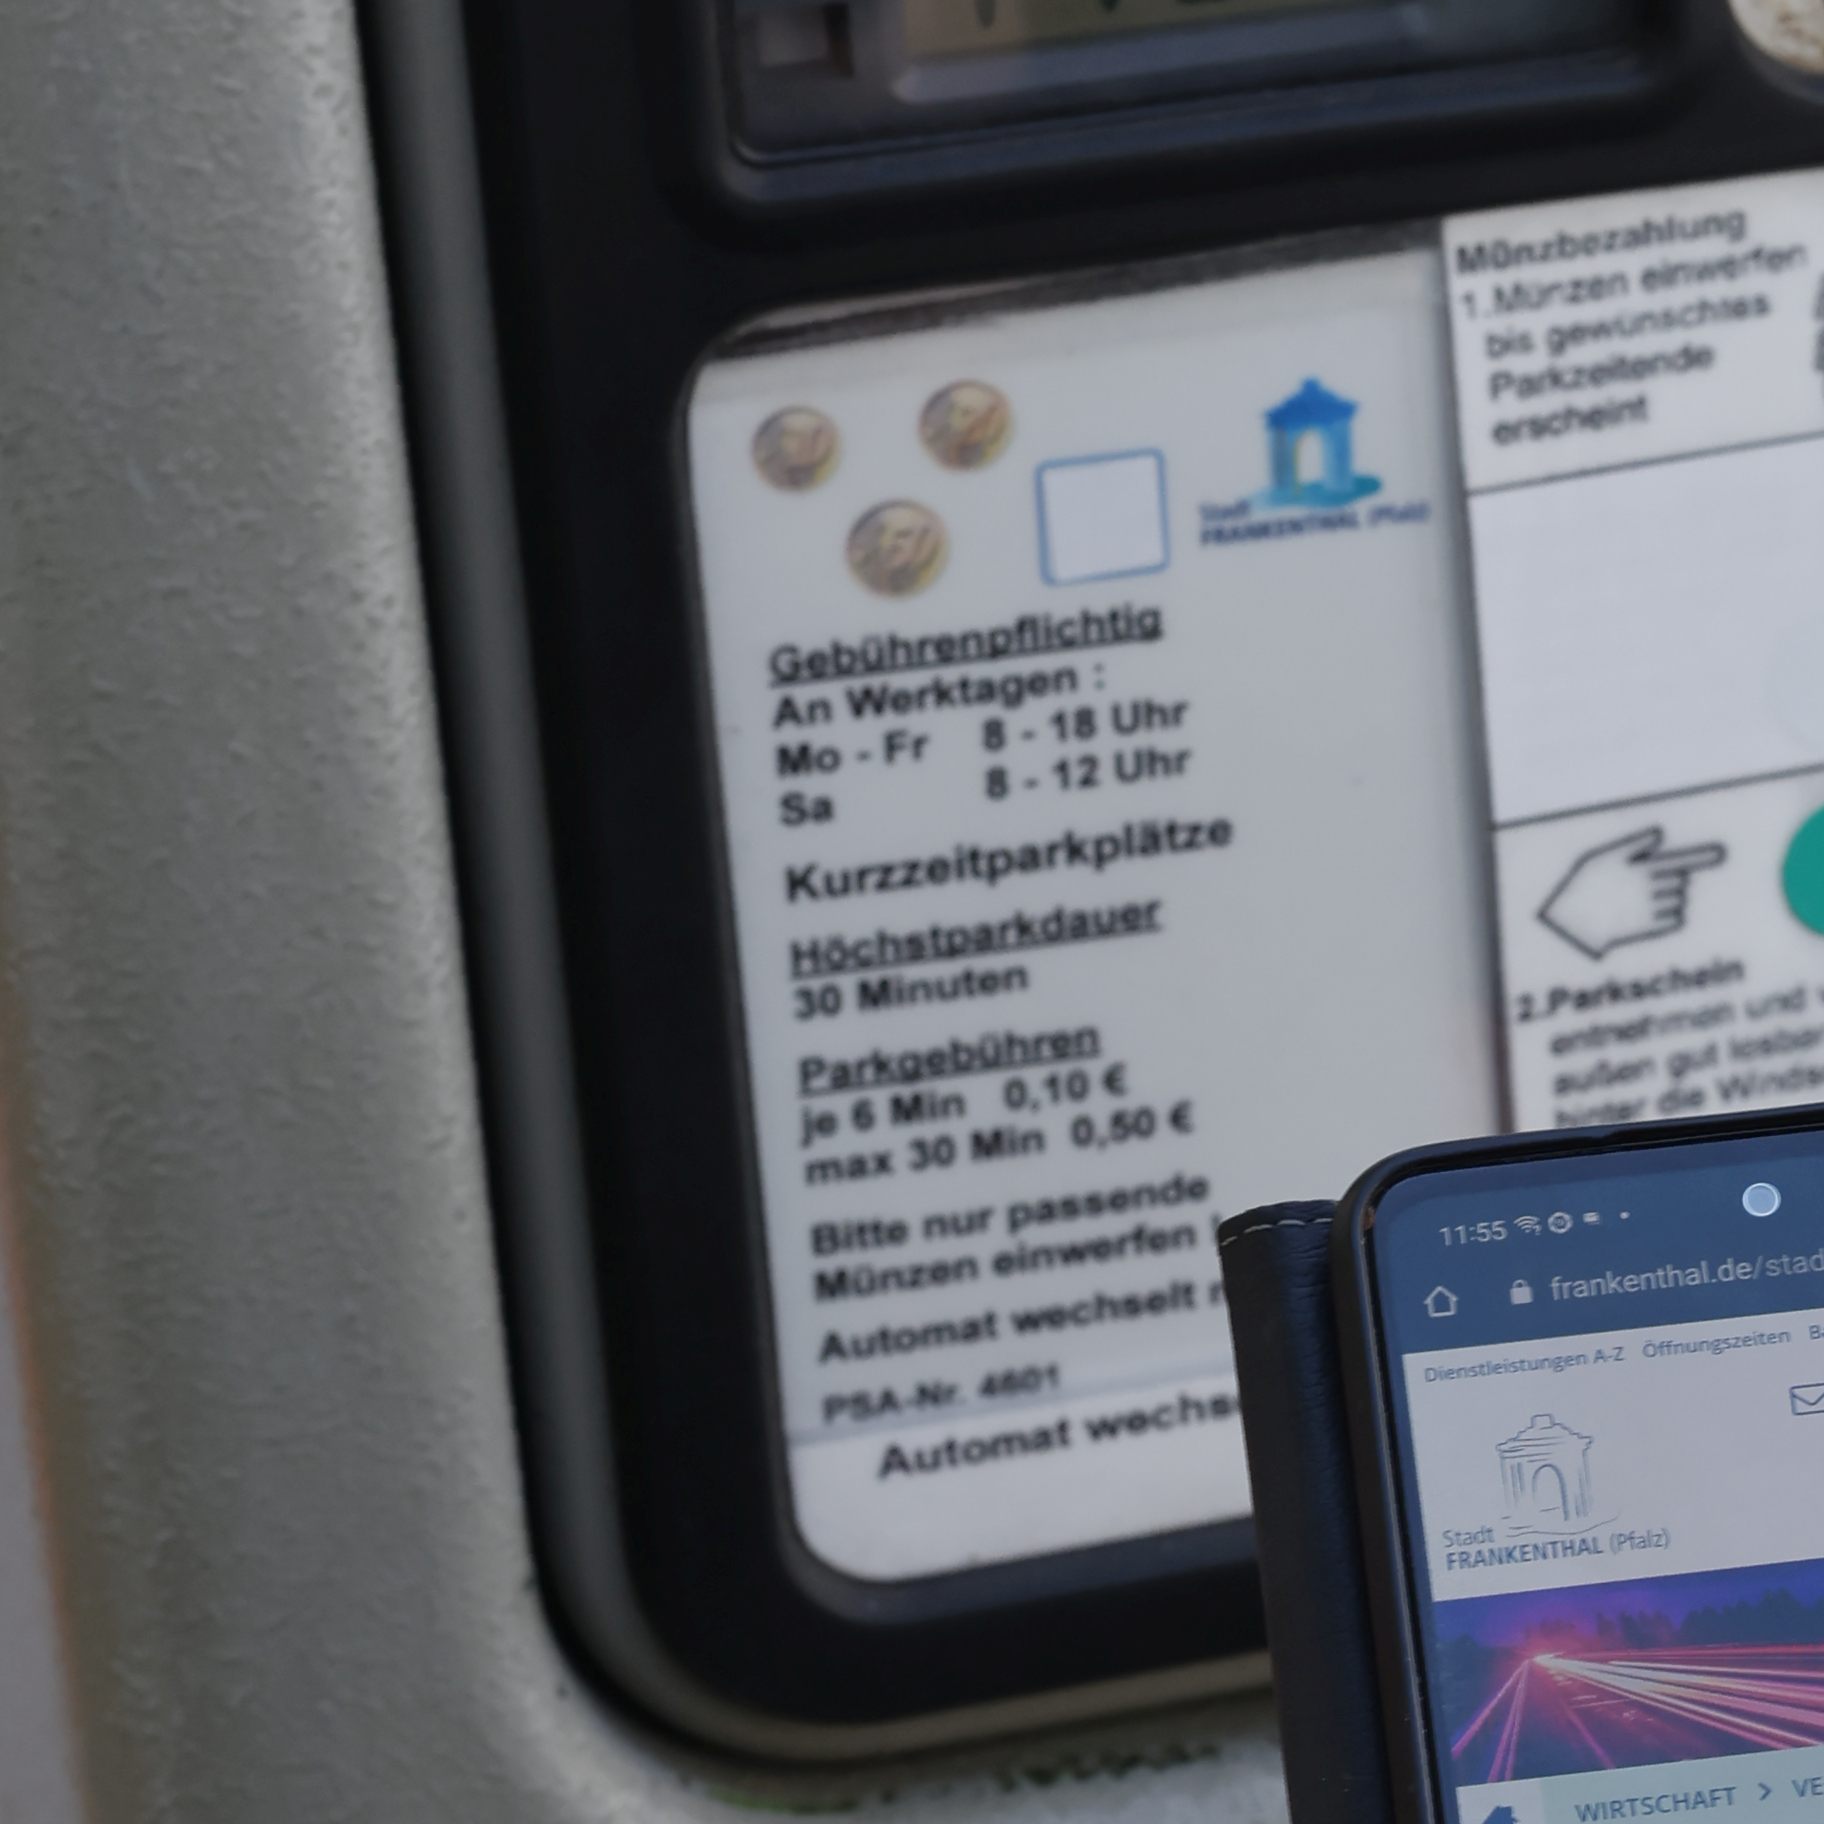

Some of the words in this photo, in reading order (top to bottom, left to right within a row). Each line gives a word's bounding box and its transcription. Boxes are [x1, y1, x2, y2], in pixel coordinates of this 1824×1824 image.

[768, 605, 1163, 689] Gebührenpflichtig
[772, 694, 833, 730] An
[844, 667, 1079, 720] Werktagen
[776, 742, 842, 778] Mo
[882, 728, 929, 765] Fr
[982, 717, 1007, 753] 8
[1050, 706, 1098, 742] 18
[1110, 698, 1189, 737] Uhr
[779, 791, 835, 828] Sa
[985, 766, 1010, 801] 8
[1053, 754, 1100, 790] 12
[1112, 746, 1192, 785] Uhr
[784, 818, 1233, 904] Kurzzeitparkplätze
[789, 900, 1161, 982] Höchstparkdauer
[795, 982, 843, 1021] 30
[856, 966, 1028, 1011] Minuten
[797, 1026, 1102, 1099] Parkgebühren
[800, 1106, 839, 1149] je
[850, 1098, 876, 1132] 6
[889, 1091, 965, 1125] Min
[1002, 1067, 1091, 1113] 0,10
[805, 1151, 893, 1185] max
[909, 1134, 957, 1171] 30
[970, 1127, 1045, 1160] Min
[1069, 1105, 1158, 1149] 0,50
[810, 1219, 909, 1257] Bitte
[922, 1207, 994, 1240] nur
[1006, 1173, 1210, 1237] passende
[1437, 1219, 1508, 1246] 11:55
[813, 1257, 979, 1302] Münzen
[990, 1223, 1197, 1278] einwerfen
[818, 1311, 998, 1365] Automat
[1010, 1281, 1196, 1335] wechselt
[1423, 1352, 1589, 1383] Dienstleistungen
[1591, 1345, 1626, 1364] A-Z
[1640, 1329, 1792, 1358] Öffnungszeiten
[877, 1418, 1071, 1479] Automat
[1441, 1524, 1495, 1550] Stadt
[1445, 1535, 1605, 1571] FRANKENTHAL
[1608, 1527, 1671, 1555] (Pfalz)
[1572, 1785, 1737, 1823] WIRTSCHAFT
